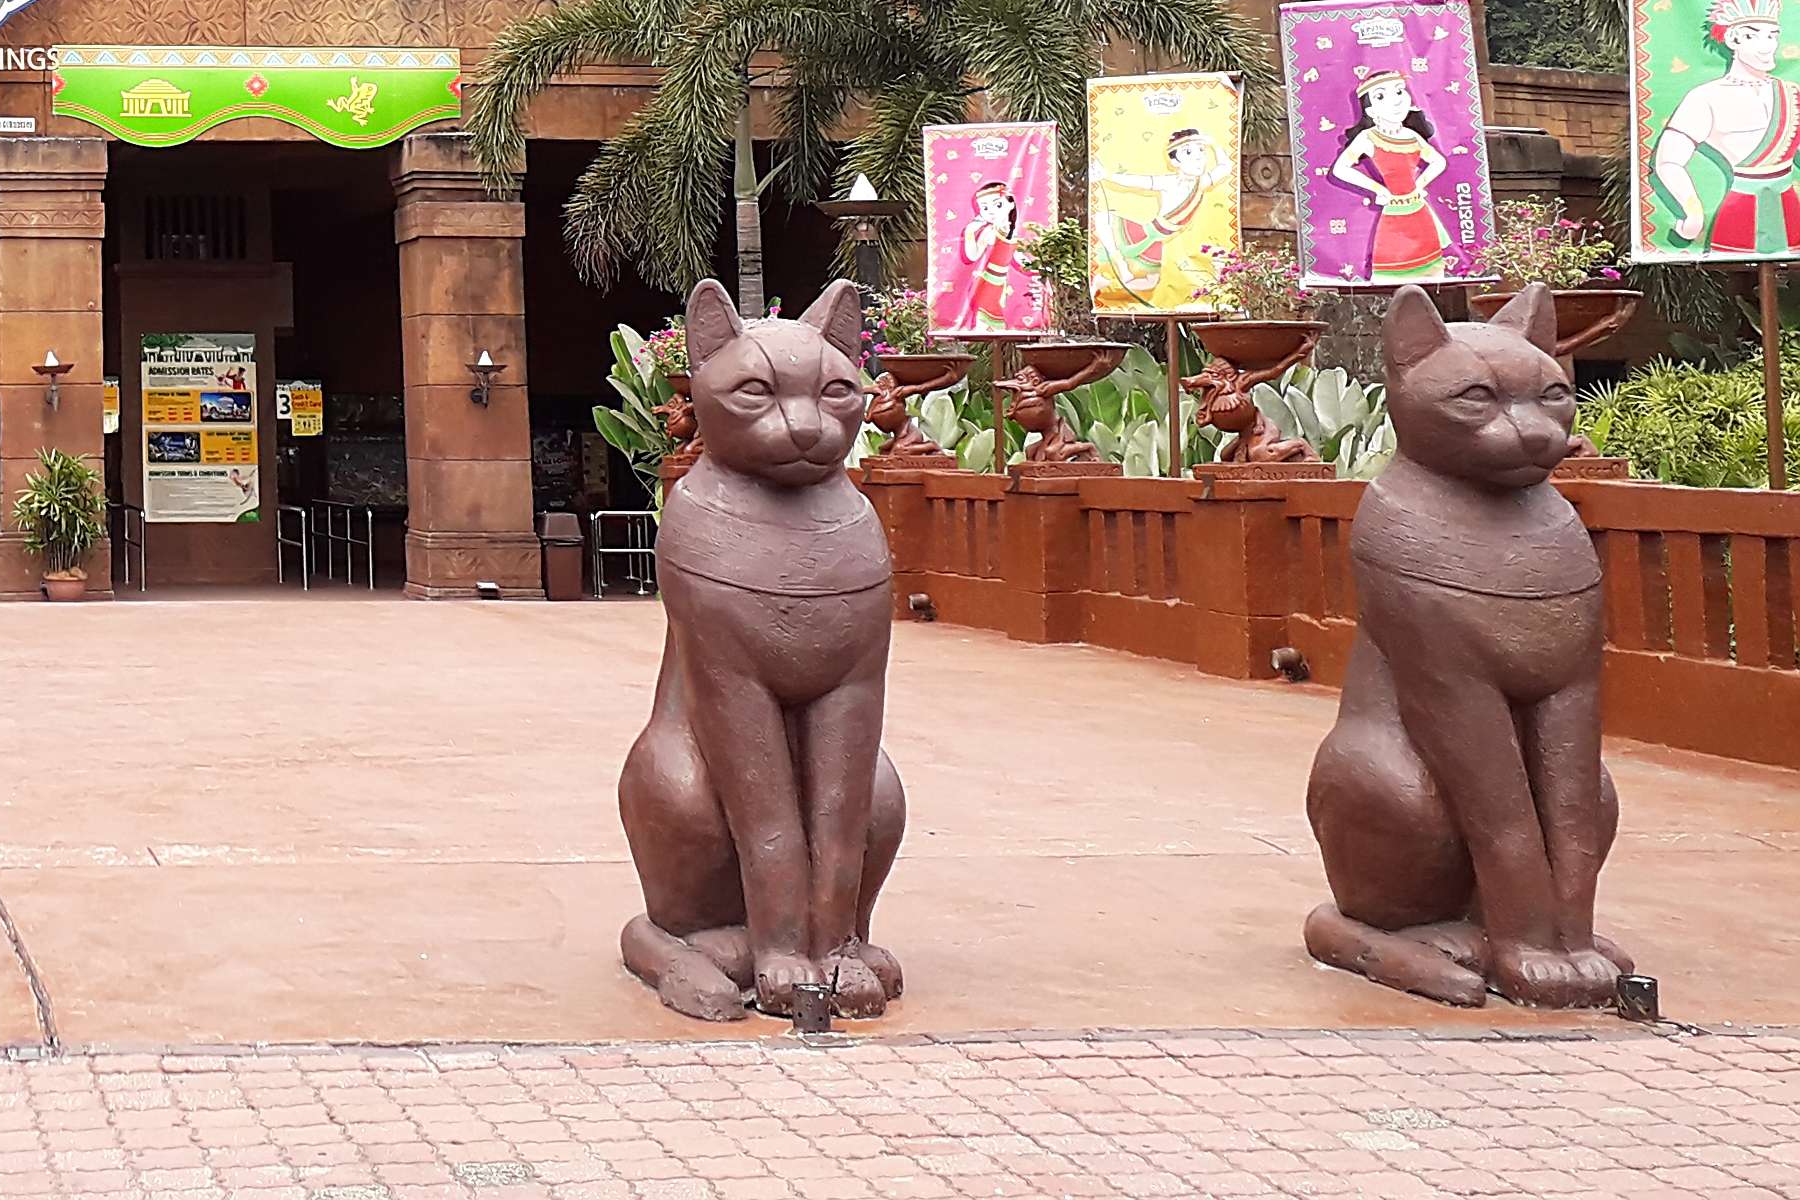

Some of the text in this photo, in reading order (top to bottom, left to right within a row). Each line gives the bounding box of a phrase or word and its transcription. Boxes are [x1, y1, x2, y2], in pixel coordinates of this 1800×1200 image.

[148, 366, 215, 376] ADMISSION RATES
[279, 394, 291, 415] 3
